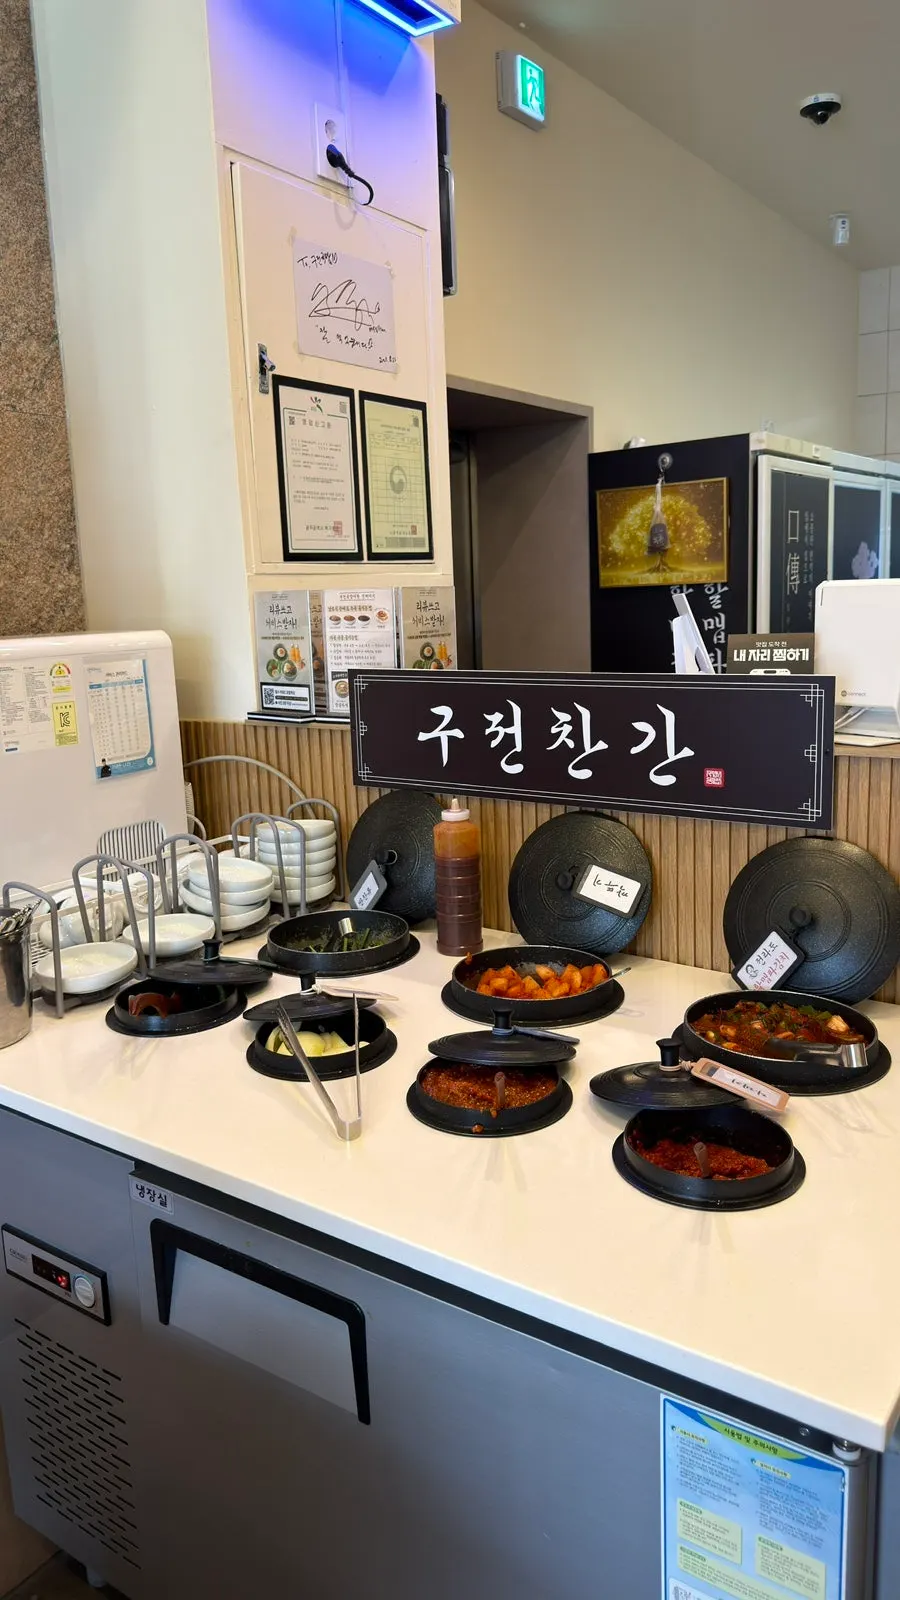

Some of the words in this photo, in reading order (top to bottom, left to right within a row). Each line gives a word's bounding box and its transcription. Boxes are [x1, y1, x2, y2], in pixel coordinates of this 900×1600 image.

[733, 649, 747, 662] 내
[747, 648, 771, 662] 자리
[772, 647, 810, 662] 찜하기
[755, 941, 779, 966] 전라도
[135, 1183, 168, 1208] 냉장실
